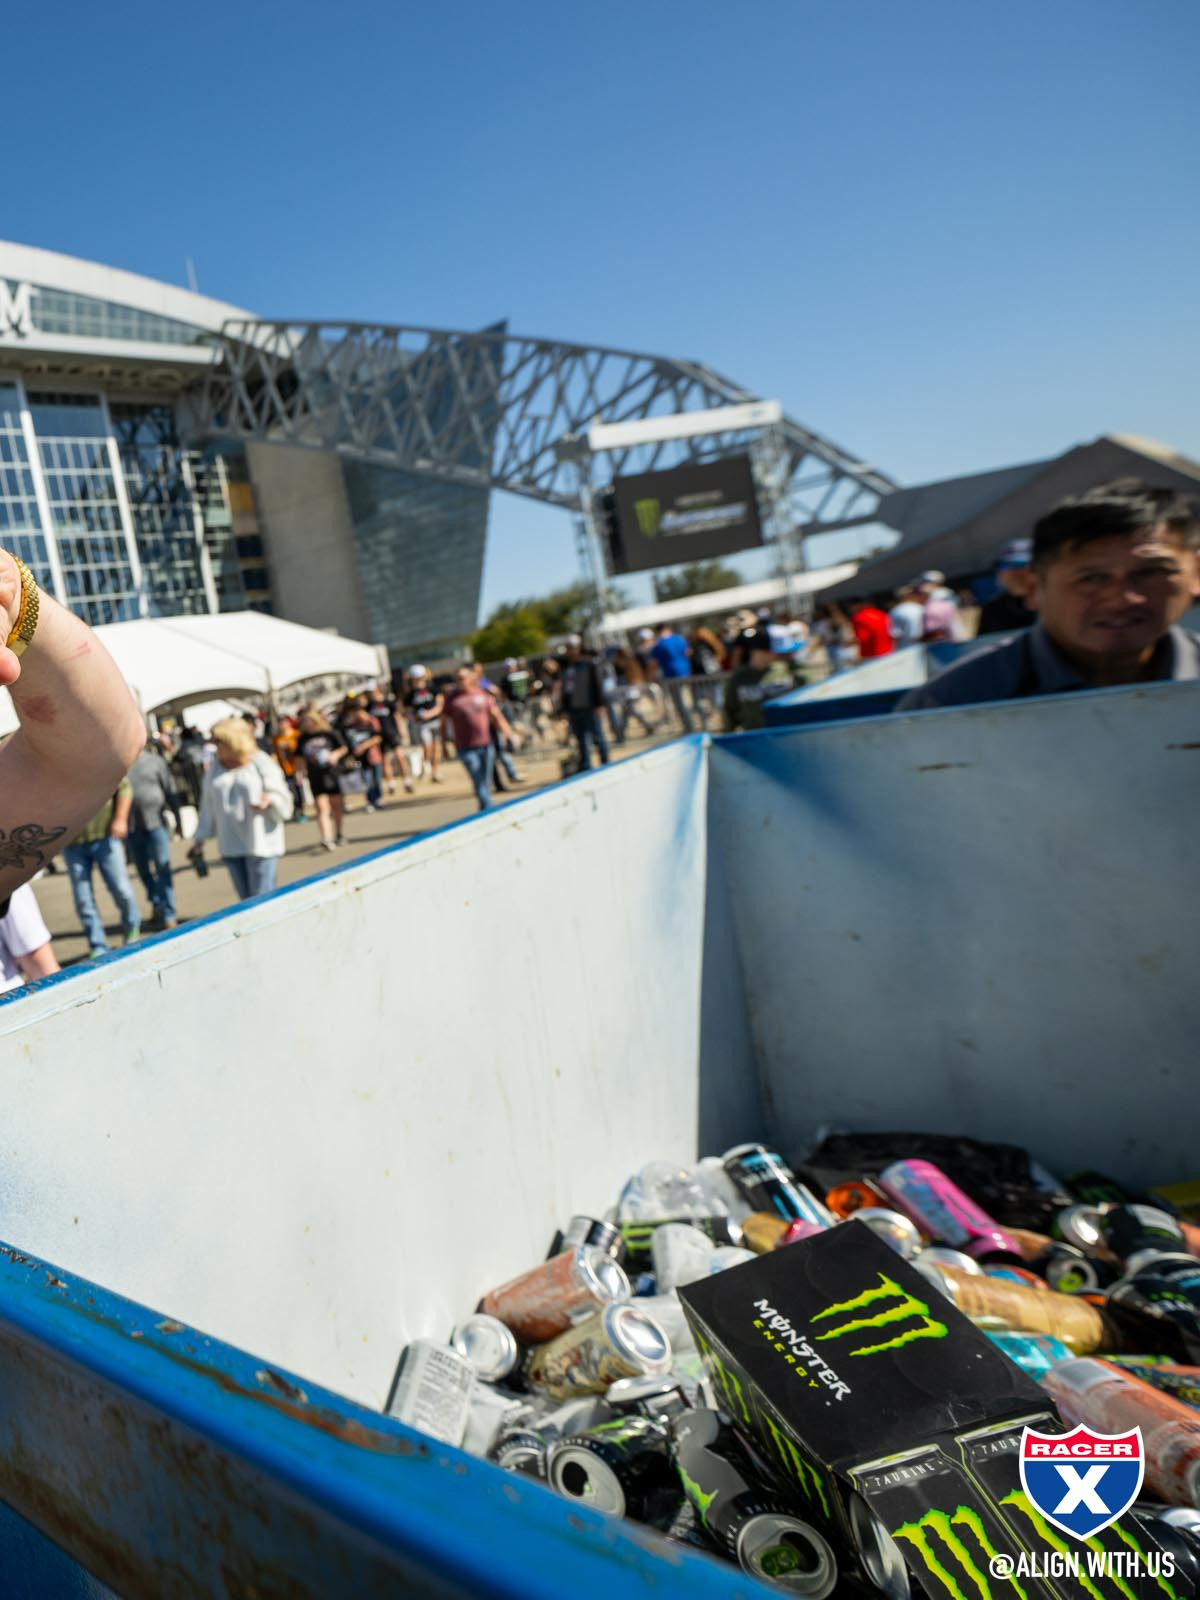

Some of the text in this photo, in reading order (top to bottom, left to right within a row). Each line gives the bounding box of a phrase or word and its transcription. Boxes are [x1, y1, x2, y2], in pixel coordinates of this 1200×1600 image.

[753, 1298, 852, 1401] MONSTER
[753, 1319, 819, 1388] ENERGY
[874, 1462, 935, 1487] TAURINE
